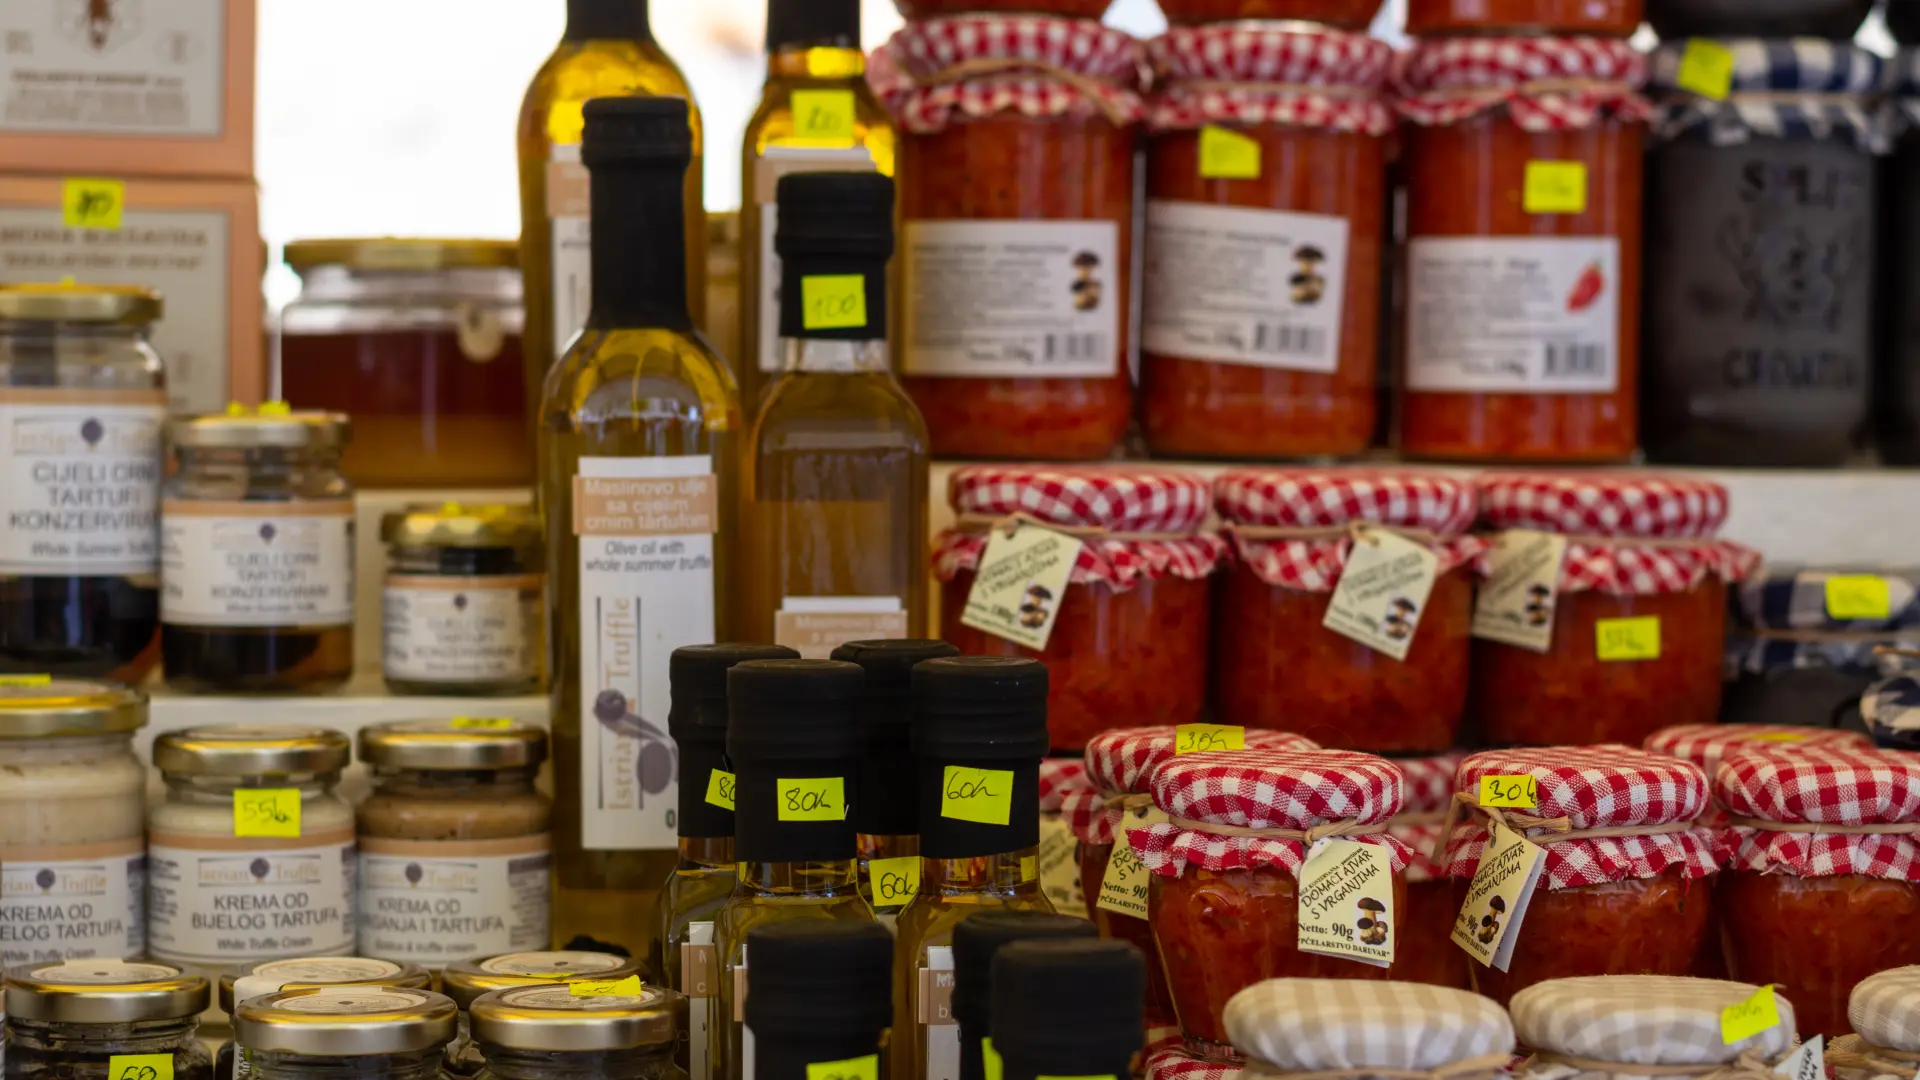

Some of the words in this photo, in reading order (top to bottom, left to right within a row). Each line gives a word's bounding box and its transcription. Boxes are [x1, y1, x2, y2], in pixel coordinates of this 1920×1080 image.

[1343, 850, 1373, 877] AJVAR
[214, 893, 280, 912] KREMA
[283, 892, 309, 909] OD
[1310, 907, 1321, 920] S
[1317, 864, 1380, 912] VRGANJIMA
[68, 903, 93, 920] OD
[378, 898, 432, 914] KREMA
[435, 898, 461, 914] OD
[56, 918, 123, 940] TARTUFA
[192, 912, 266, 931] BIJELOG
[271, 907, 339, 928] TARTUFA
[430, 916, 506, 933] TARTUFA
[1332, 922, 1354, 941] 90g
